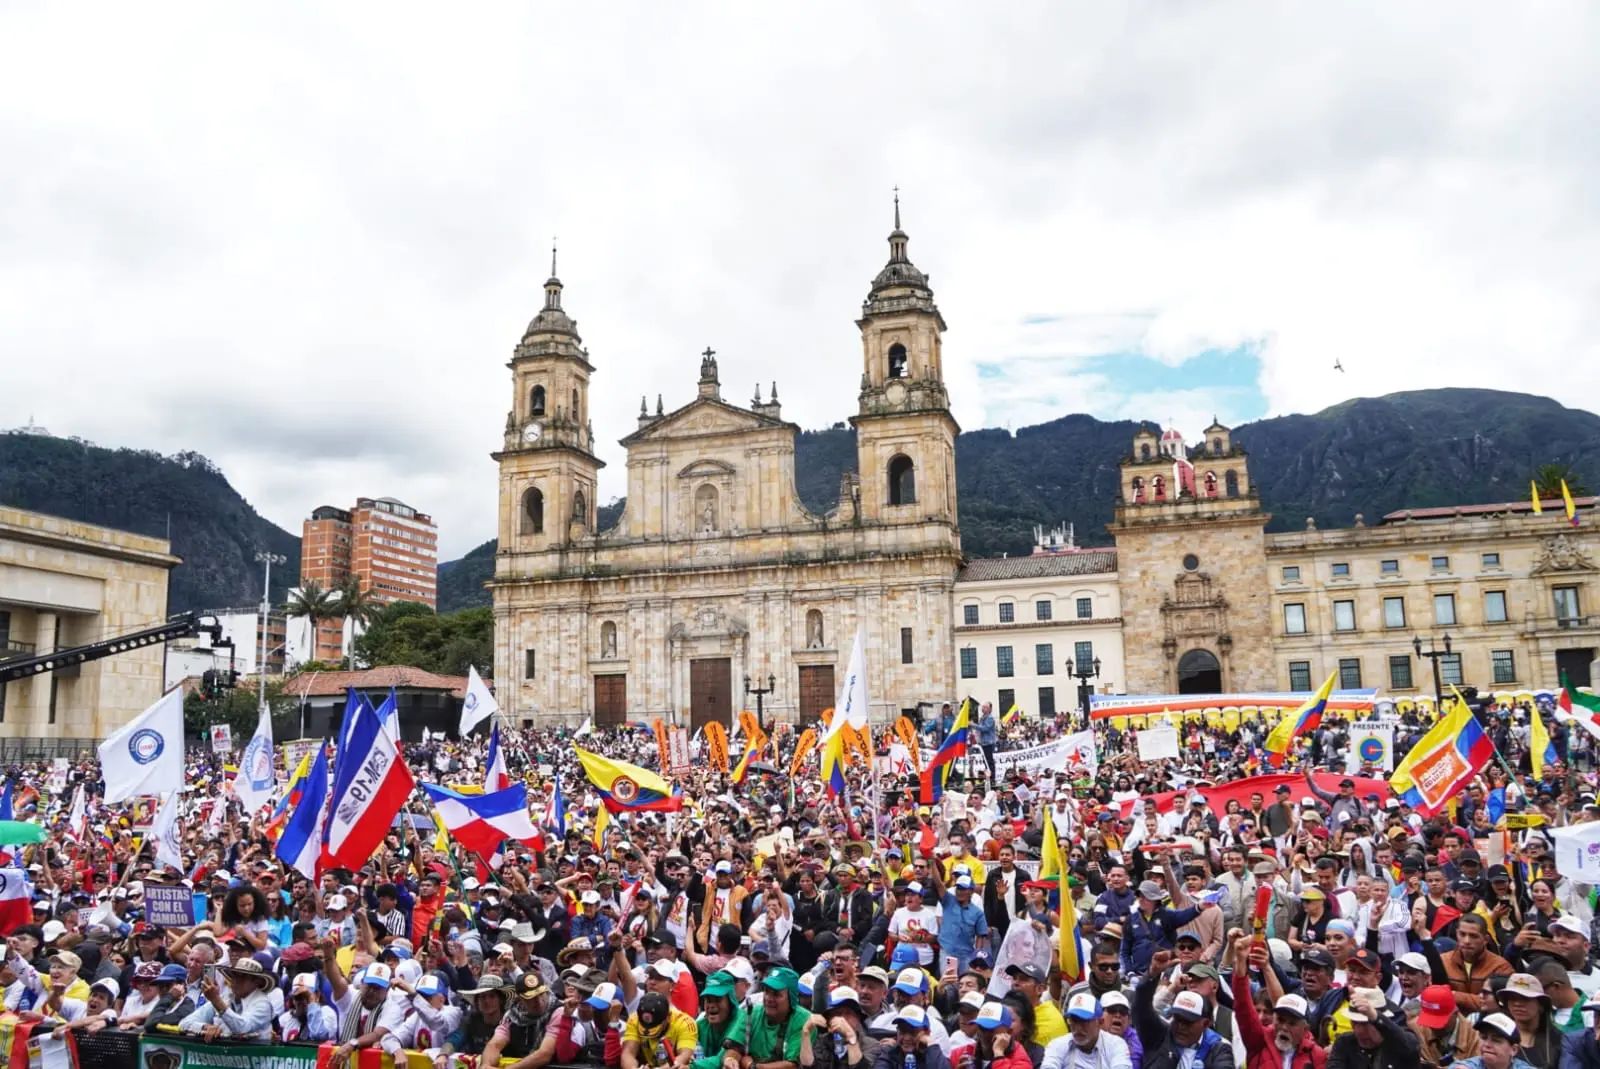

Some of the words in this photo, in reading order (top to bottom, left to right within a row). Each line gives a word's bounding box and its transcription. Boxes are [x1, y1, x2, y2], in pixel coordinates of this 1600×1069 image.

[146, 887, 190, 900] ARTISTAS
[152, 900, 172, 912] CON
[173, 901, 184, 912] EL
[150, 912, 189, 924] CAMBIO
[187, 1050, 251, 1068] RESGUARDO
